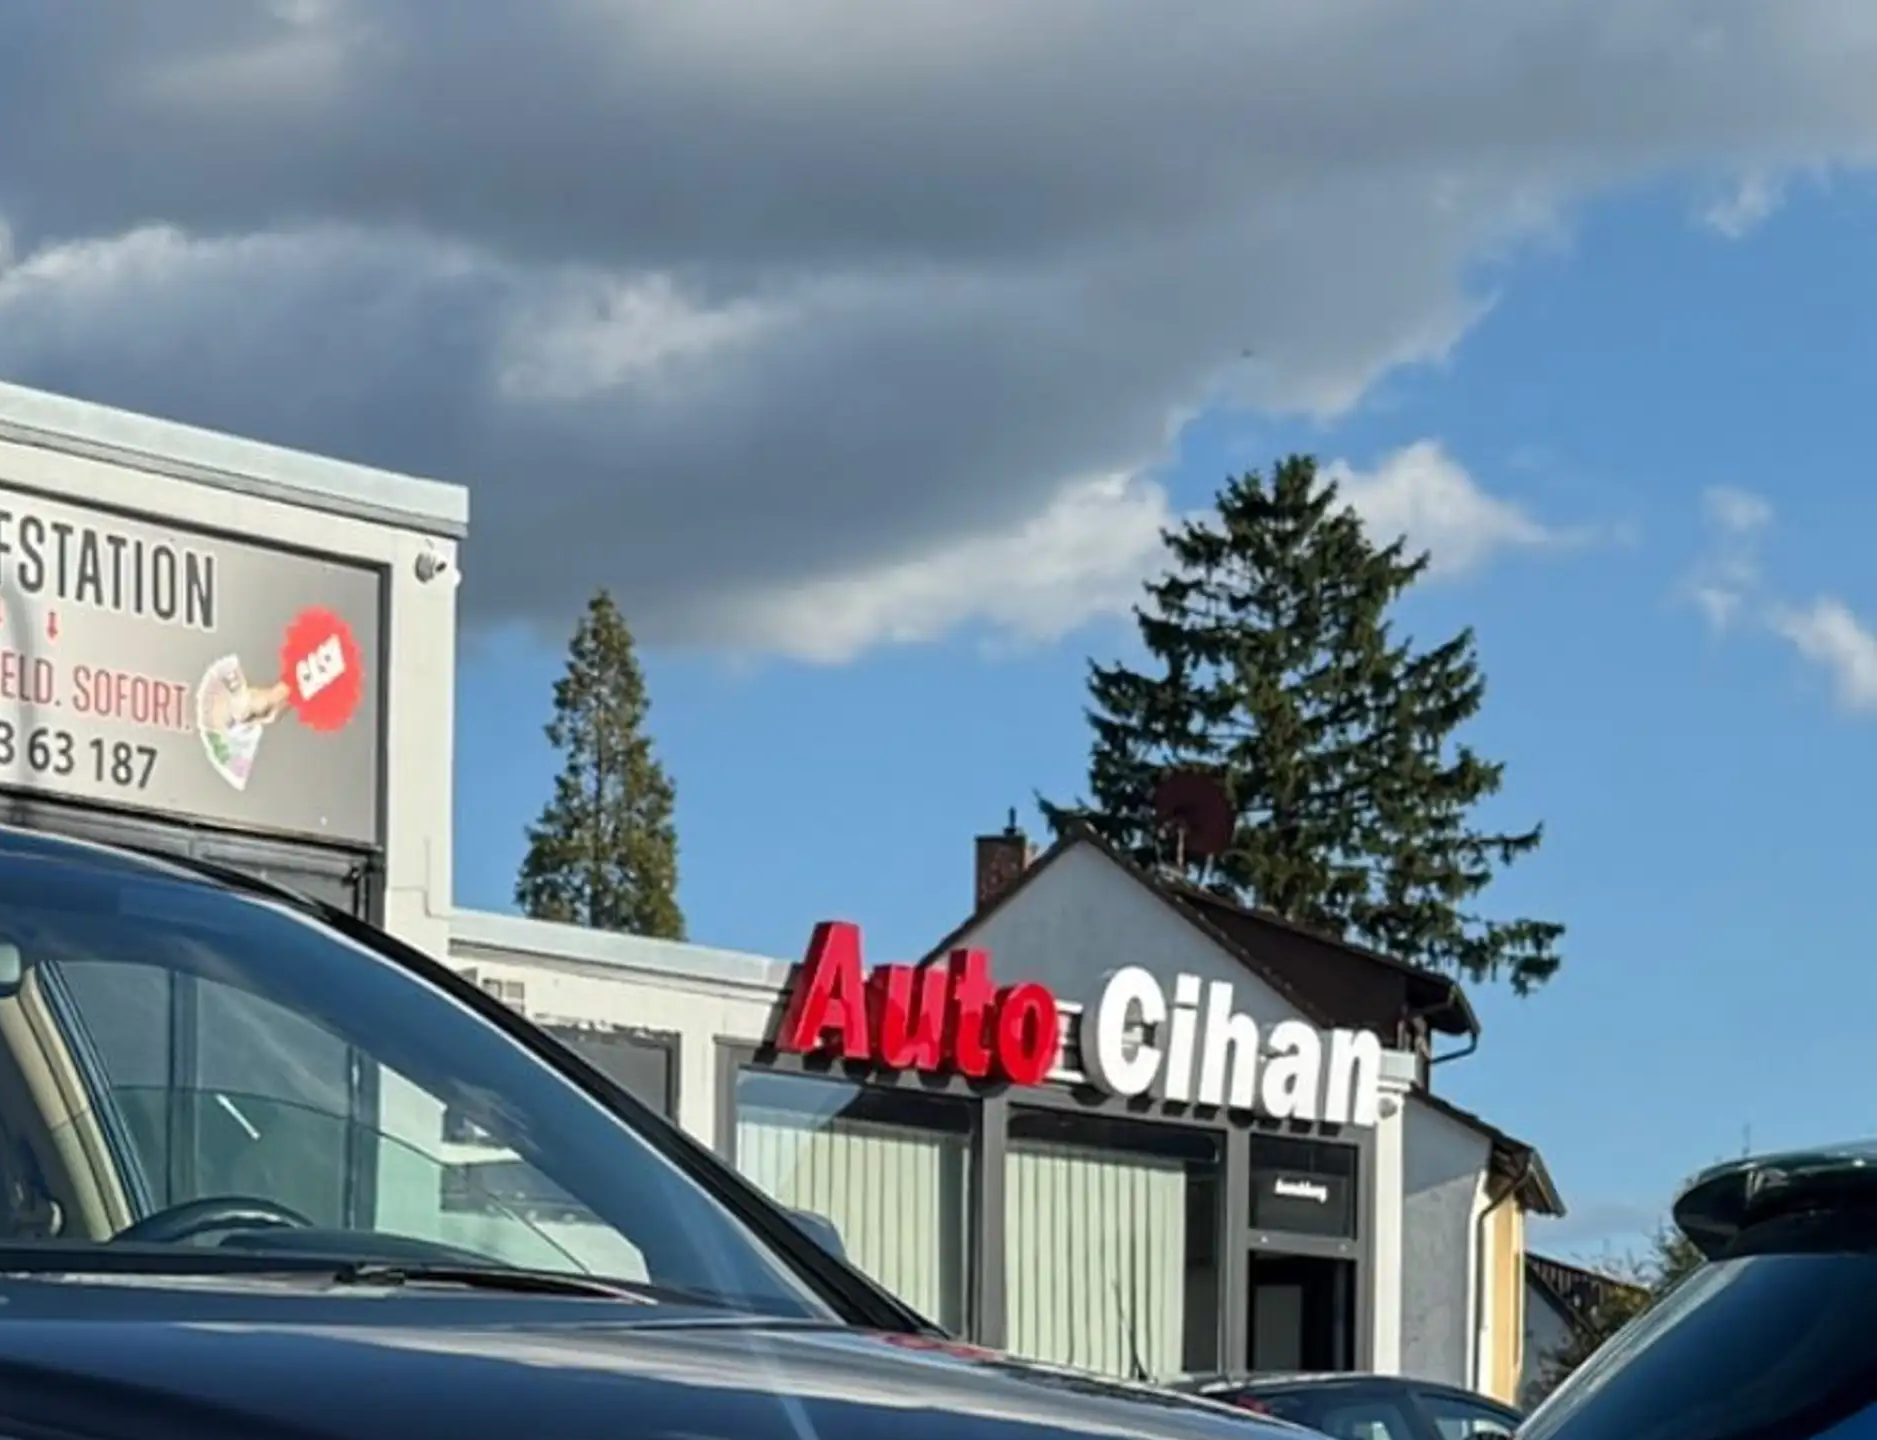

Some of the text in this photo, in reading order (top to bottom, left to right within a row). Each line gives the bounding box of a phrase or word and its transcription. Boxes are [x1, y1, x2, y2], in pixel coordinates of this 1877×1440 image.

[73, 665, 191, 730] SOFORT.
[28, 727, 74, 775] 63
[89, 737, 158, 790] 187
[780, 920, 1382, 1127] Auto Cihan
